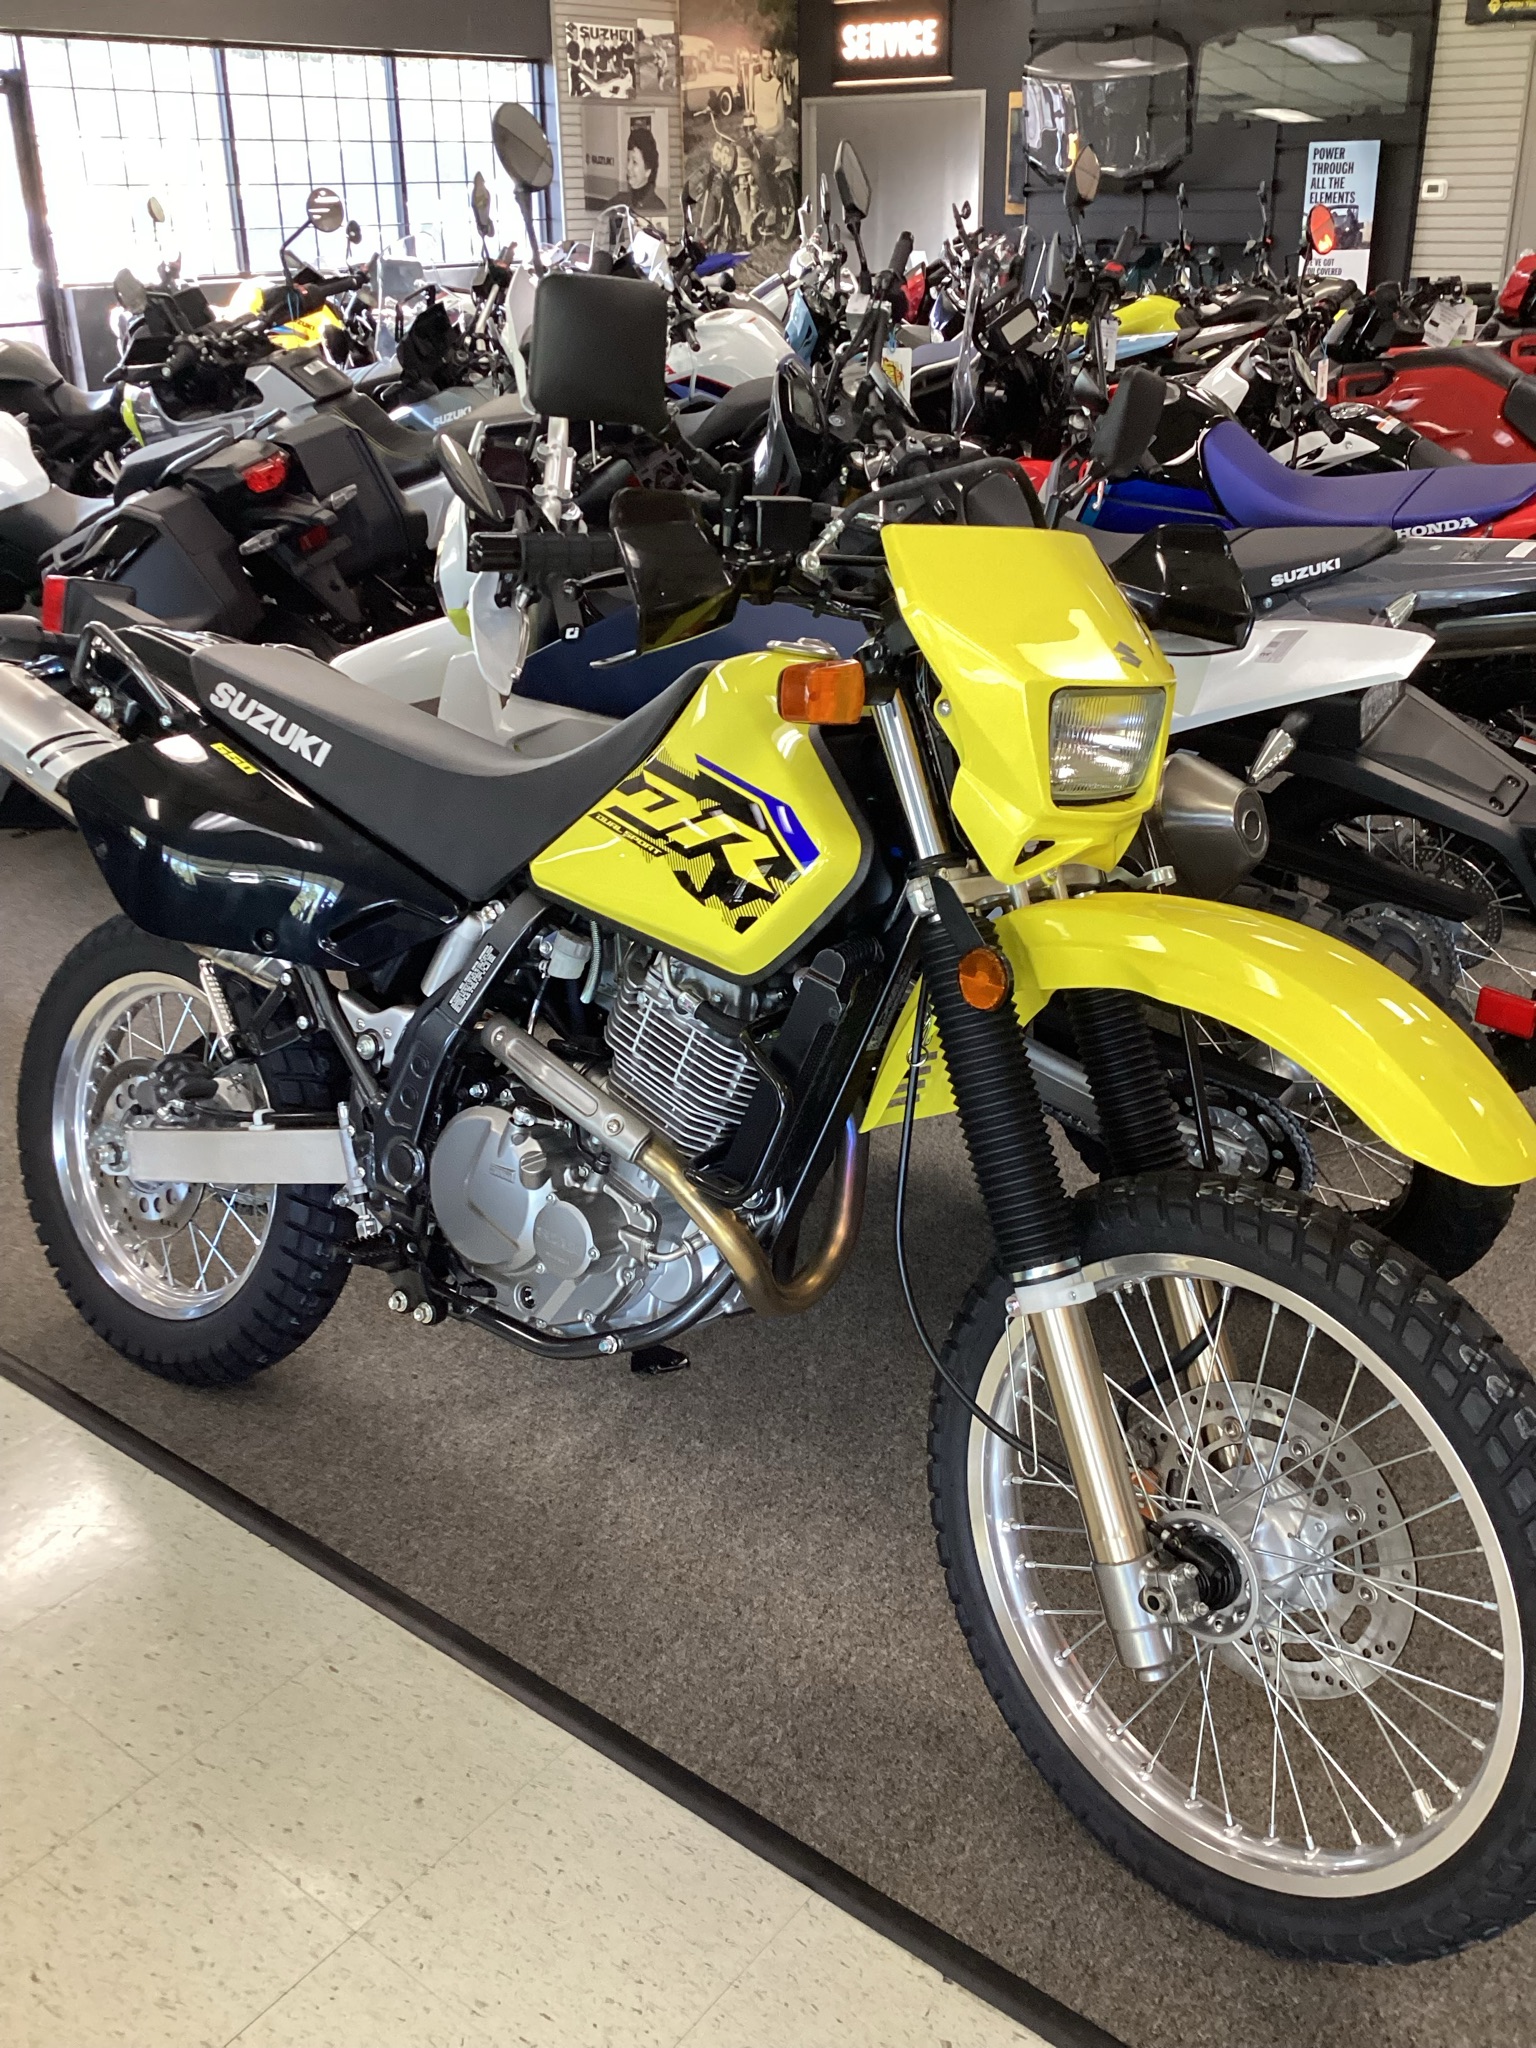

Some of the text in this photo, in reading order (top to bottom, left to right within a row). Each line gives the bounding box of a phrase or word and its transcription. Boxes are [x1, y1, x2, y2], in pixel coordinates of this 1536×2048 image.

[842, 19, 937, 60] SERVICE
[1313, 147, 1345, 160] POWER
[1312, 162, 1354, 175] THROUGH
[1310, 176, 1345, 190] ALL THE
[1309, 191, 1356, 204] ELEMENTS
[1317, 267, 1342, 276] COVERED
[1323, 258, 1335, 266] GOT
[433, 406, 472, 426] SUZUKI
[1395, 516, 1478, 539] HONDA
[1270, 557, 1341, 588] SUZUKI
[209, 681, 333, 768] SUZUKI
[210, 742, 259, 775] 650
[595, 813, 663, 855] DUAL SPORT
